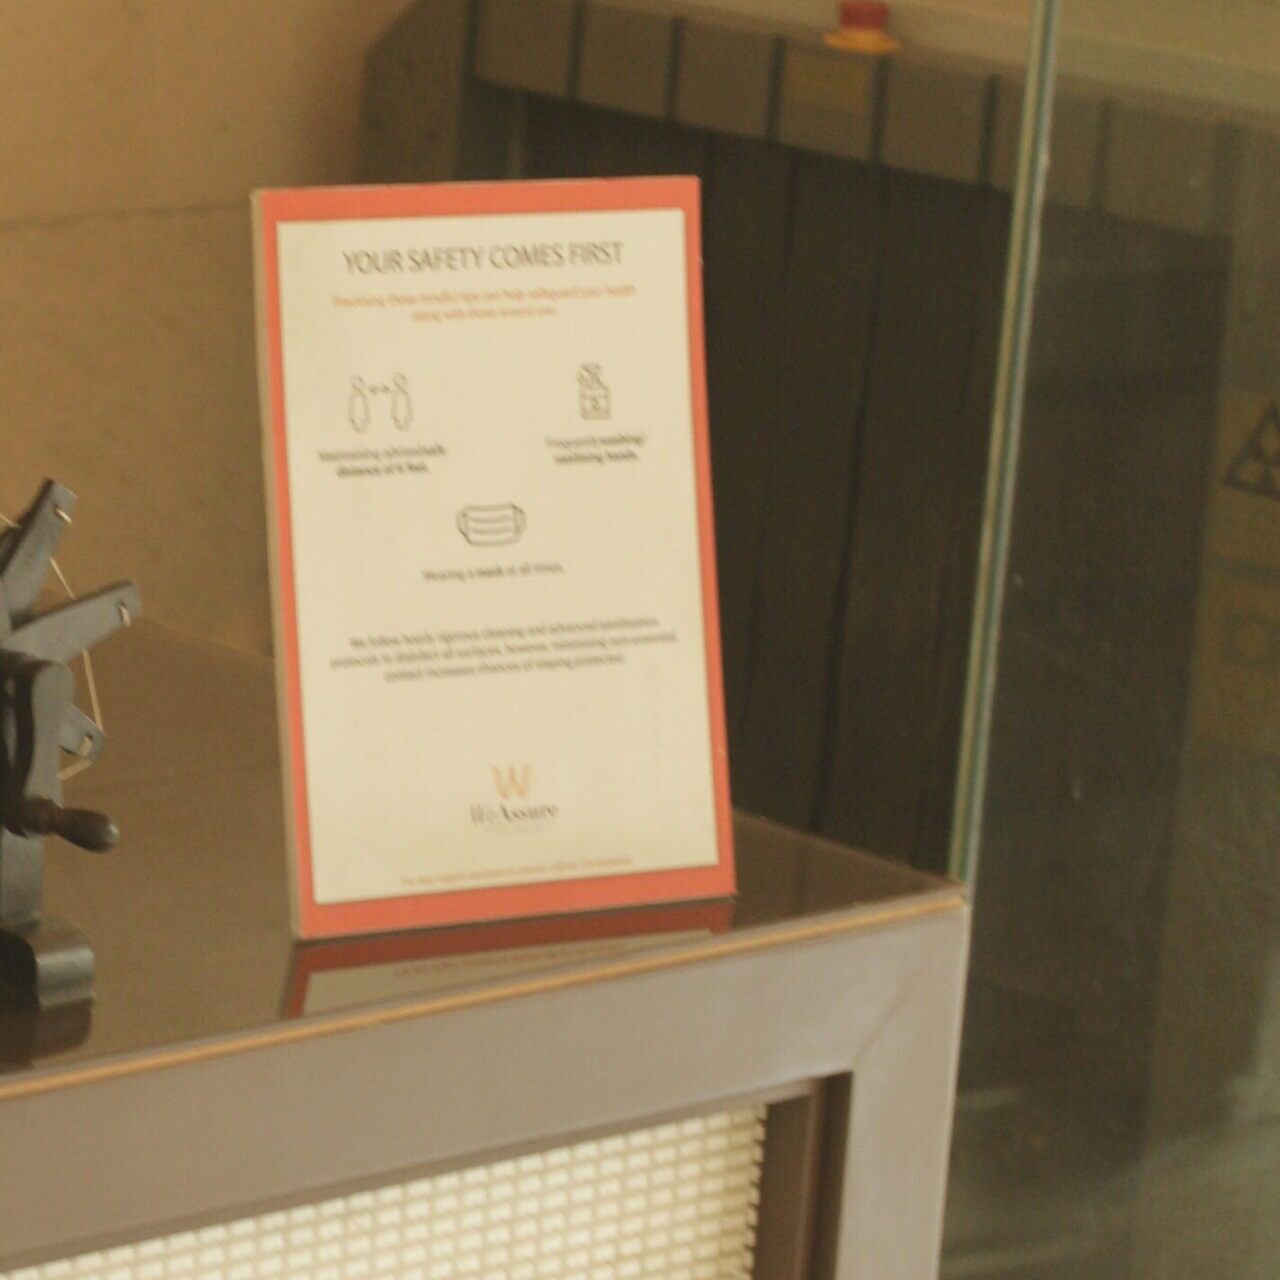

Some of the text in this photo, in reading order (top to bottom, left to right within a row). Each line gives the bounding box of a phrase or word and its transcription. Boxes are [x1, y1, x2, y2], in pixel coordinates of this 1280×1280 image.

[342, 240, 625, 274] YOUR SAFETY COMES FIRST
